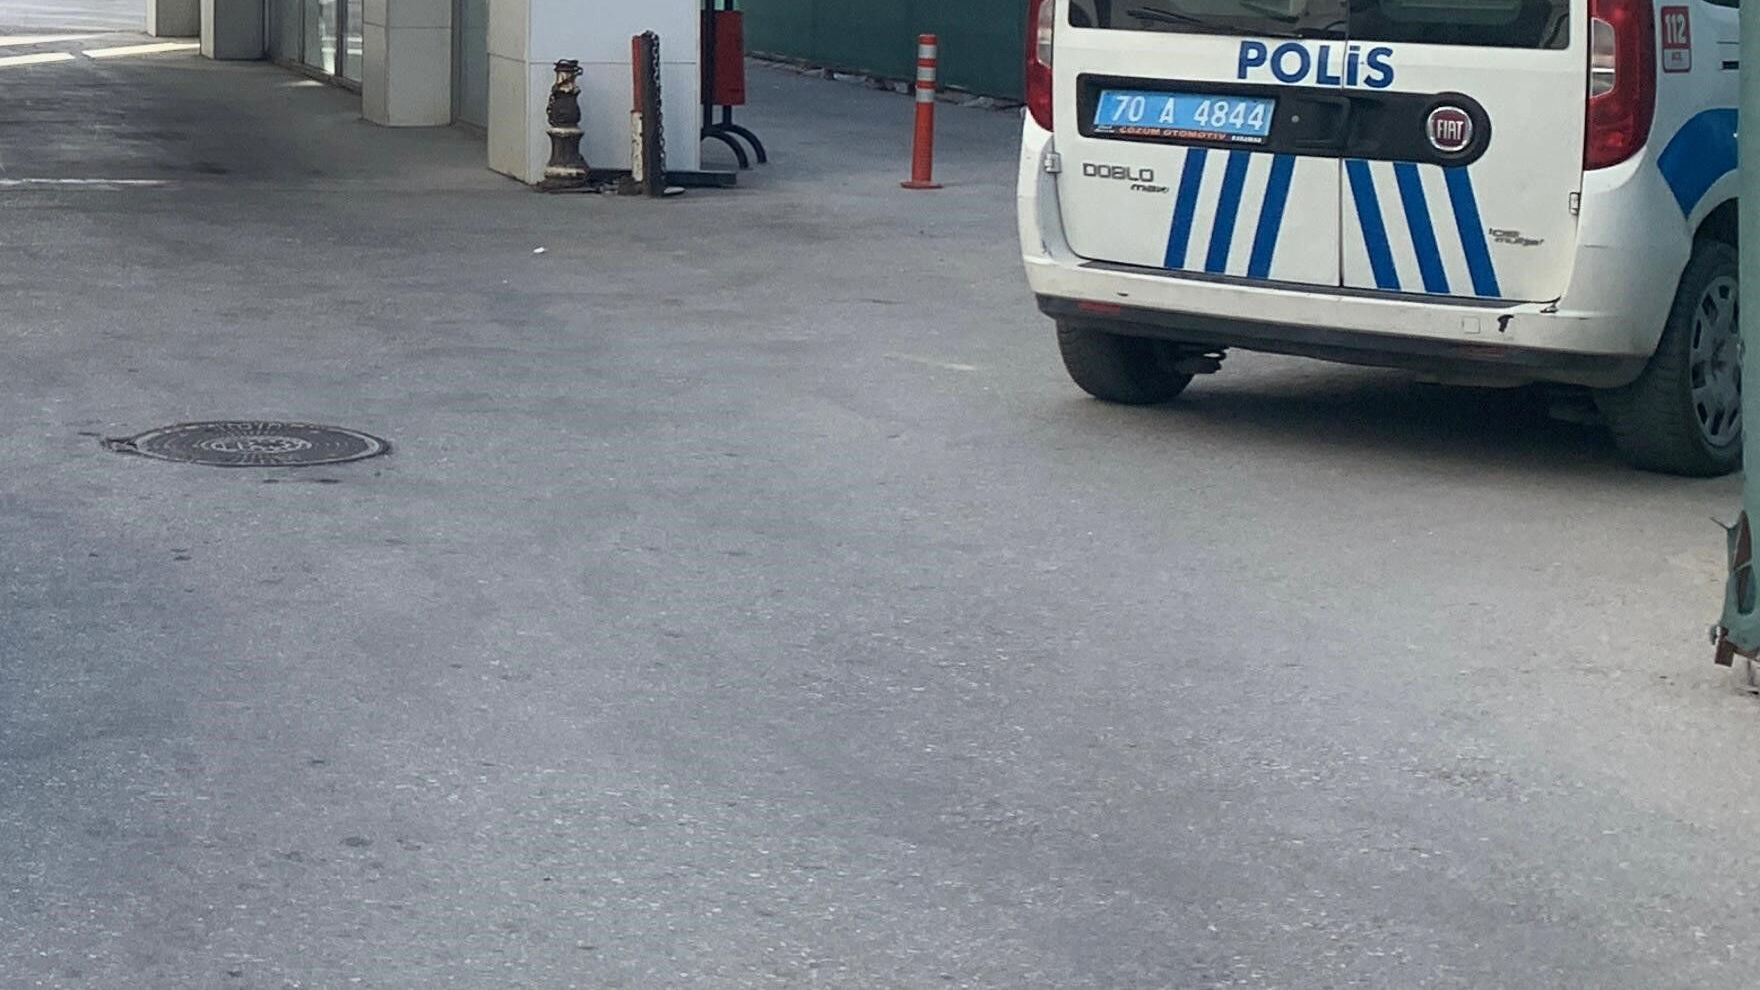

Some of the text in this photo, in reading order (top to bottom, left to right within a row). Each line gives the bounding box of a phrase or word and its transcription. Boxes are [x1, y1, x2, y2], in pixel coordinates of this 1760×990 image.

[1665, 13, 1686, 44] 112
[1237, 41, 1395, 89] POLİS
[1112, 95, 1266, 131] 70 A 4844
[1437, 120, 1464, 141] FIAT
[1083, 163, 1154, 182] DOBLO
